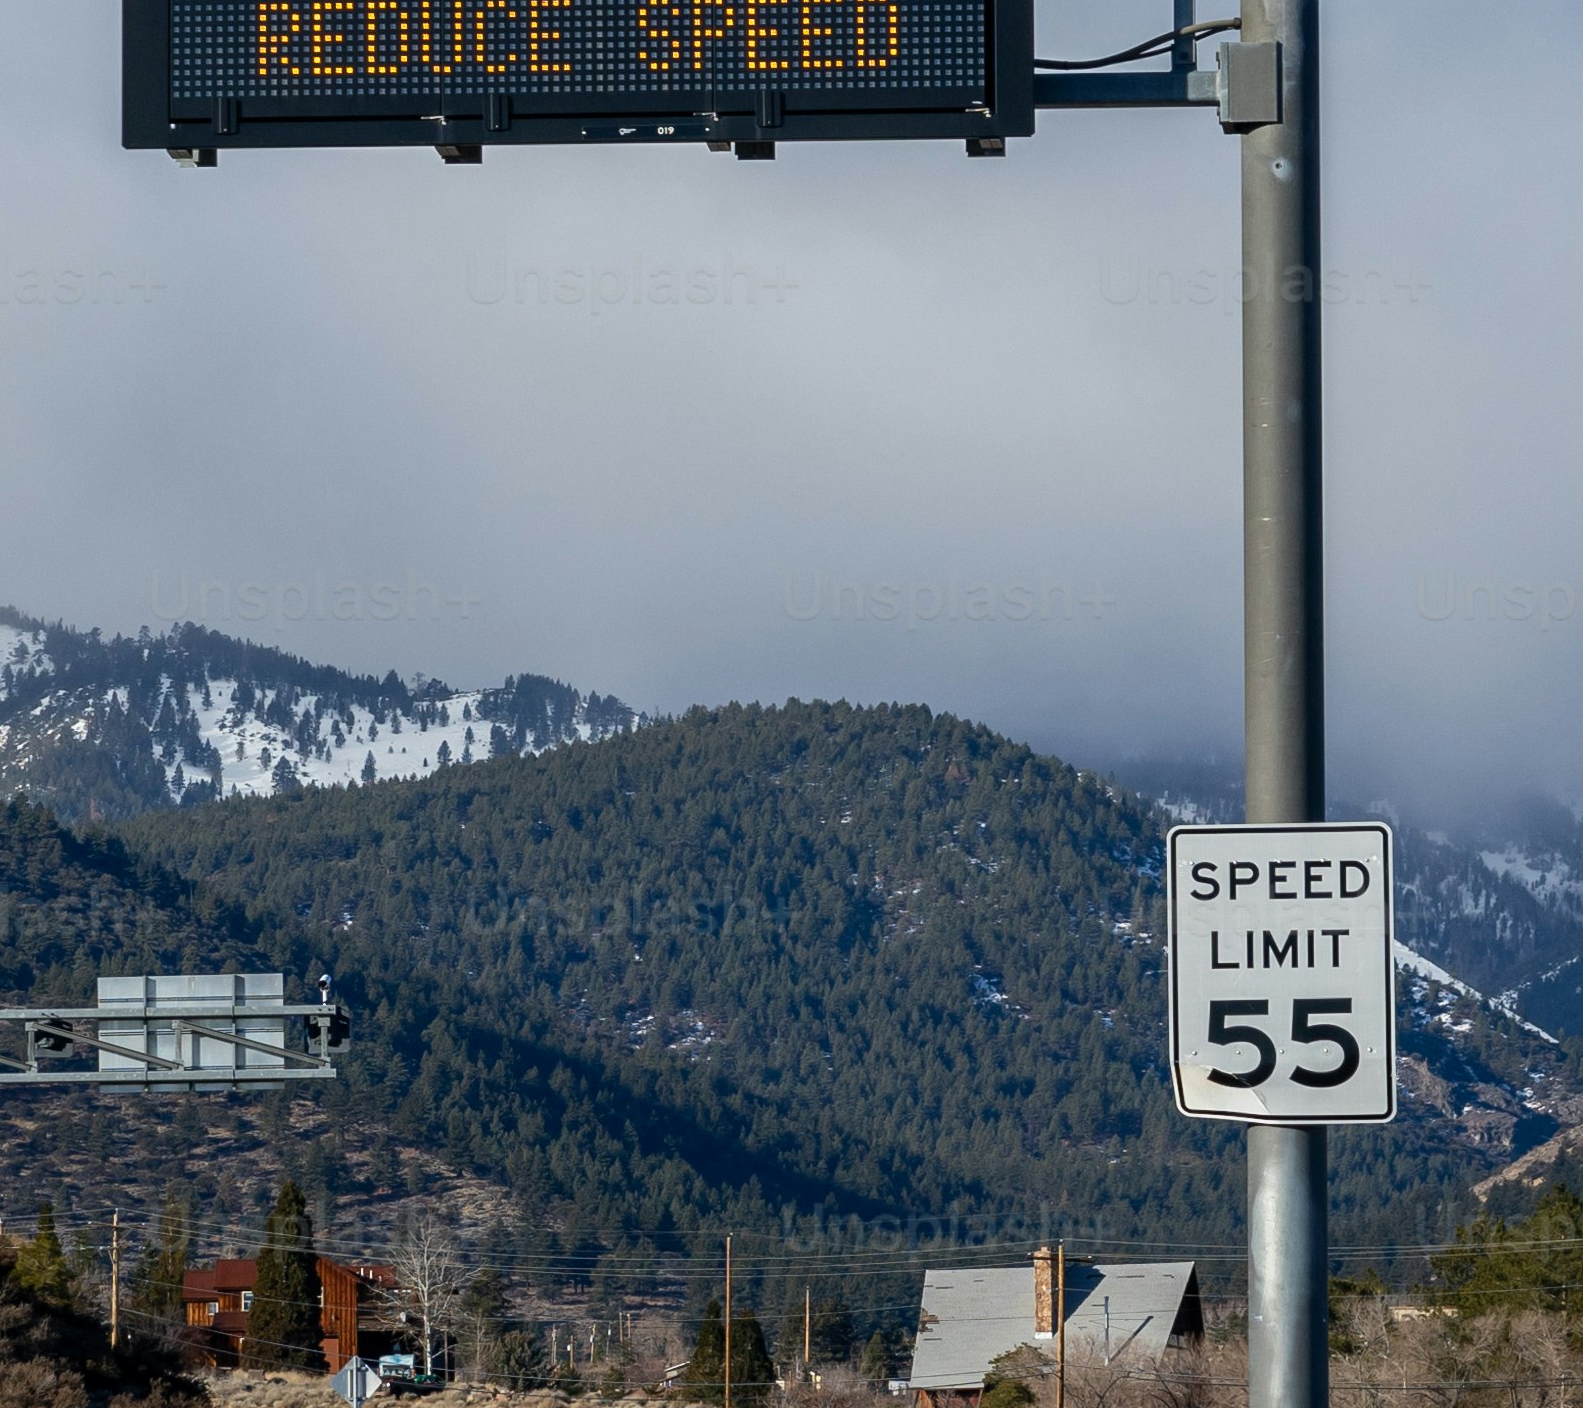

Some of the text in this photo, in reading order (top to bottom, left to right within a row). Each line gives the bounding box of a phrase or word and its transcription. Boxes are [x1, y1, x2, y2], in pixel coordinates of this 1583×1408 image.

[259, 0, 572, 75] REDUCE
[657, 126, 675, 135] 019
[1190, 860, 1371, 901] SPEED
[1211, 929, 1350, 970] LIMIT
[1206, 997, 1360, 1089] 55
